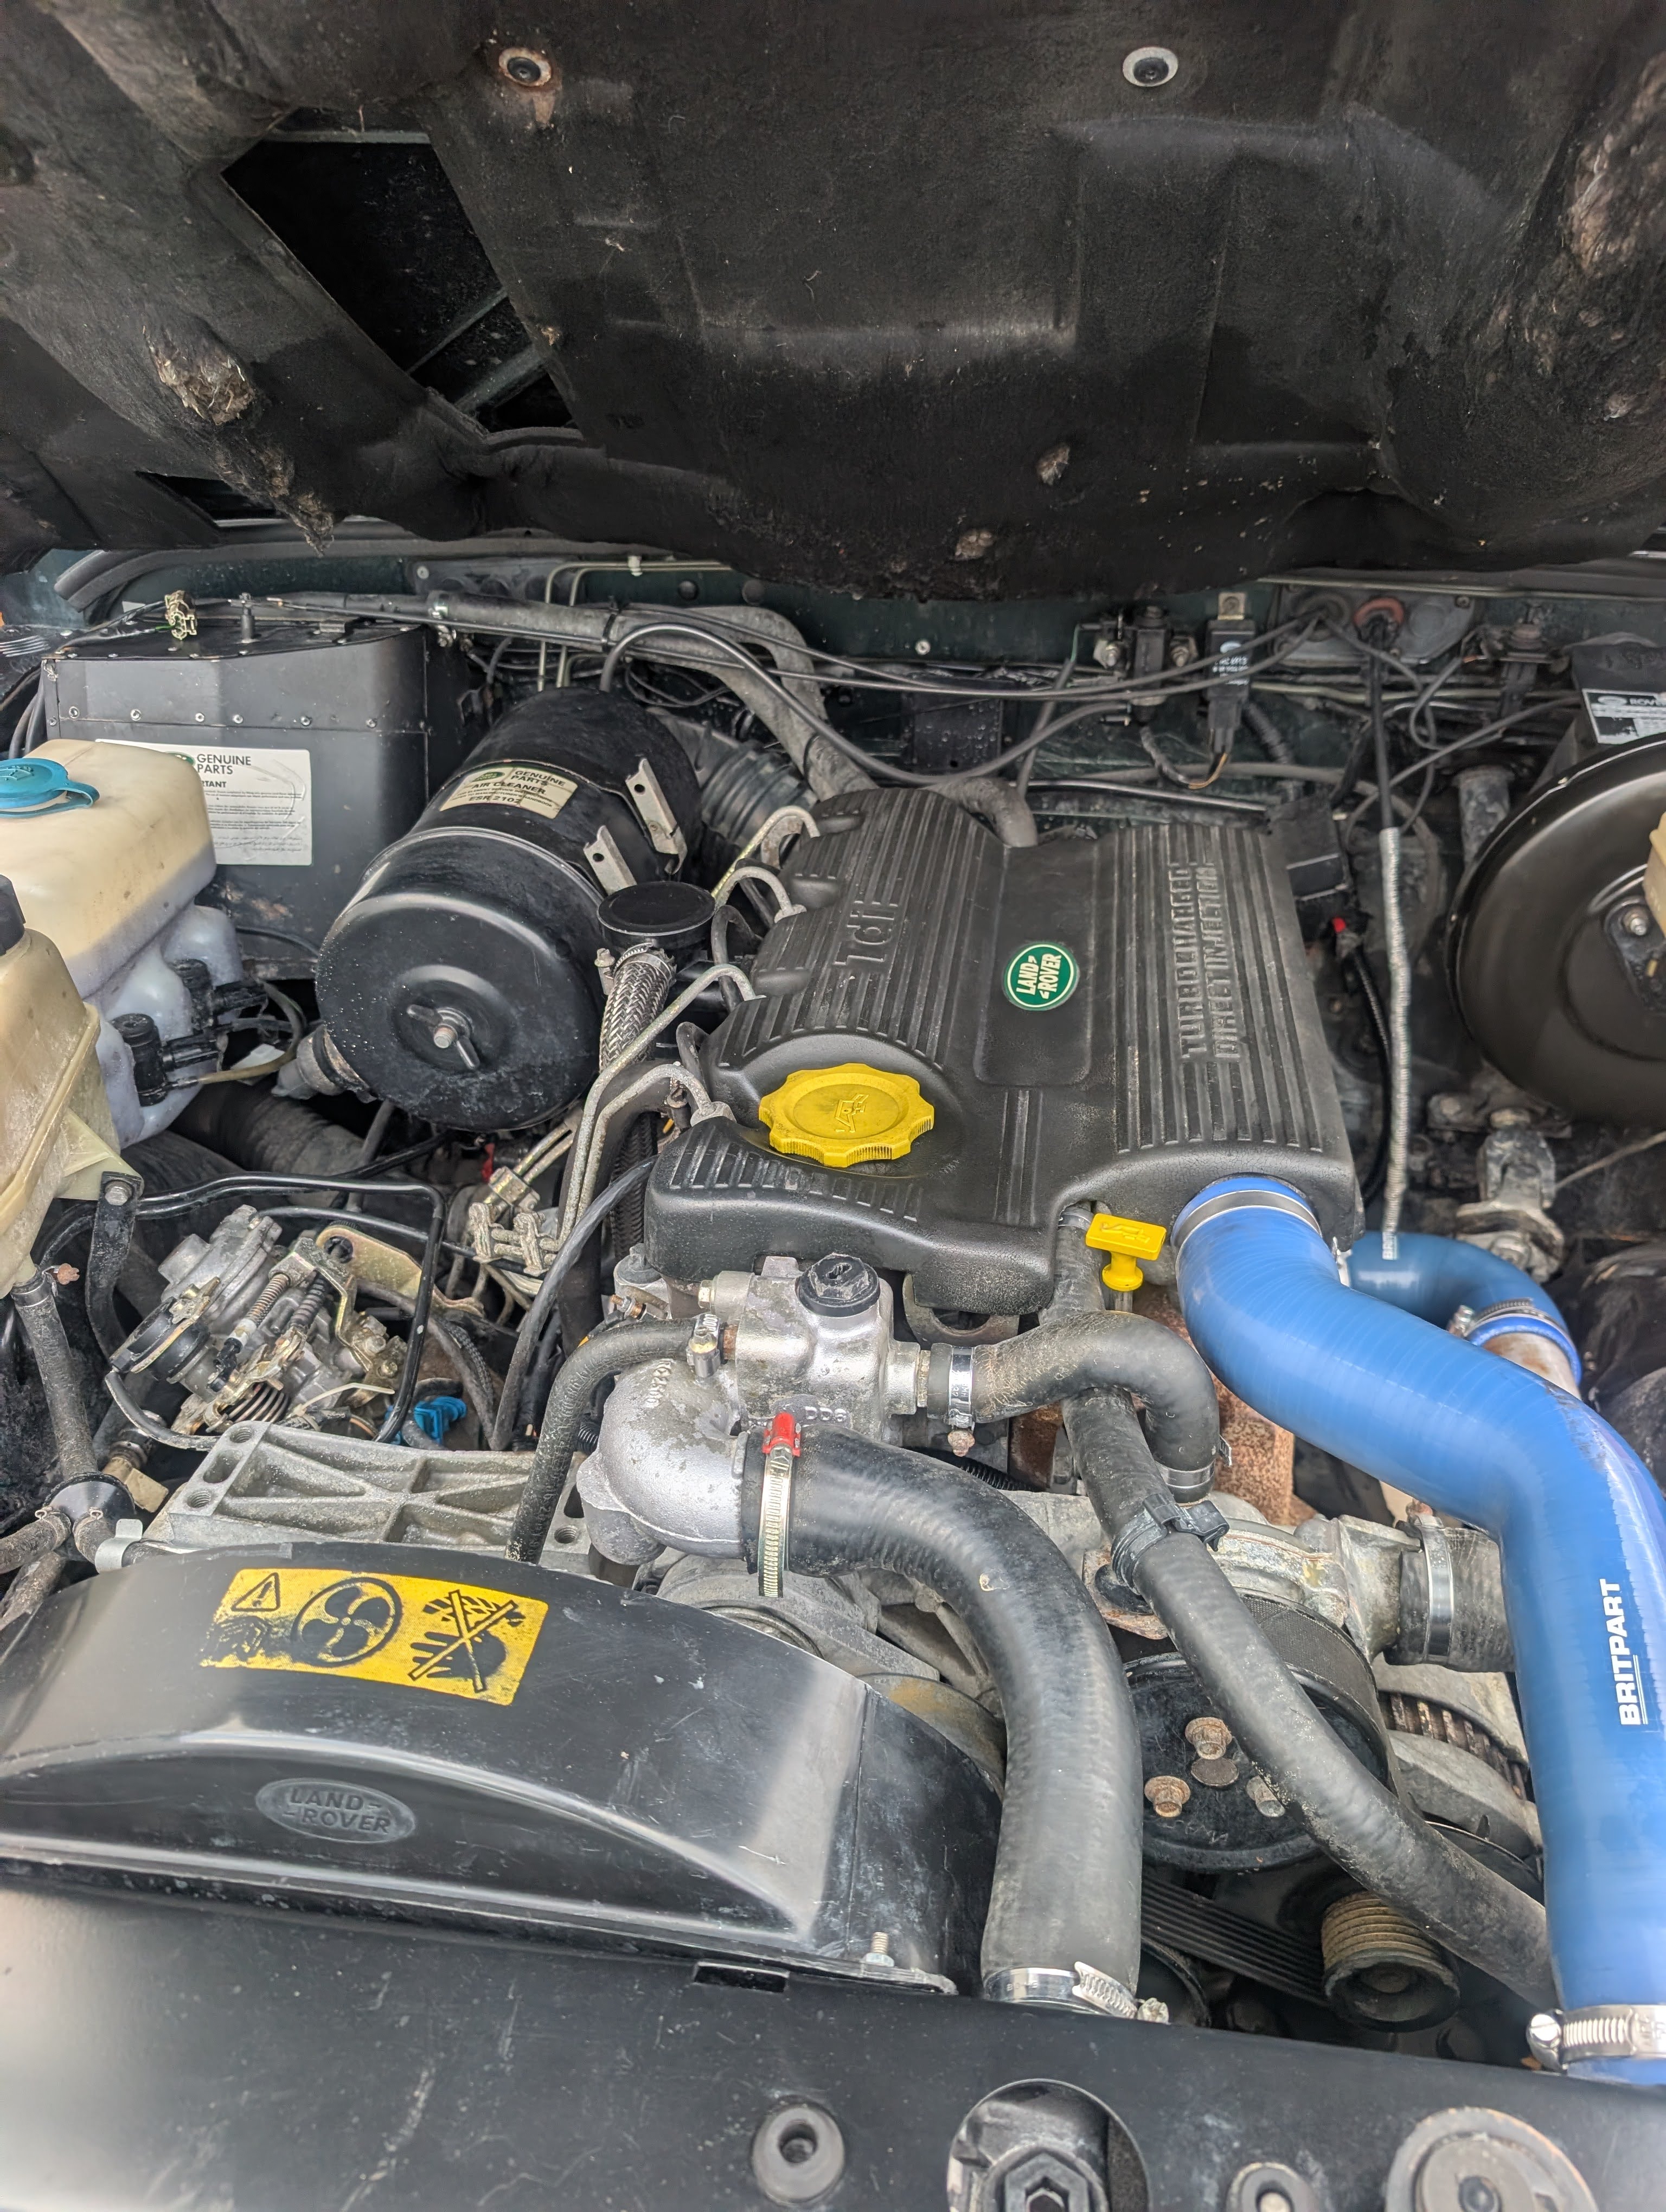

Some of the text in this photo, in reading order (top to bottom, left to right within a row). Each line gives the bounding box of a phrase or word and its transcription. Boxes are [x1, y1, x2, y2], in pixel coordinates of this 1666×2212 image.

[197, 754, 252, 766] GENUINE
[197, 764, 233, 775] PARTS
[494, 781, 546, 794] CLEANER
[511, 775, 548, 786] PARTS
[515, 770, 566, 787] GENUINE
[1037, 953, 1062, 993] ROVER
[1168, 869, 1208, 1058] TURBOCHARGED
[1196, 867, 1240, 1058] DIRECT INJECTION
[1016, 962, 1040, 996] LAND
[1599, 1578, 1641, 1725] BRITPART
[290, 1788, 364, 1811] LAND
[302, 1808, 392, 1834] ROVER
